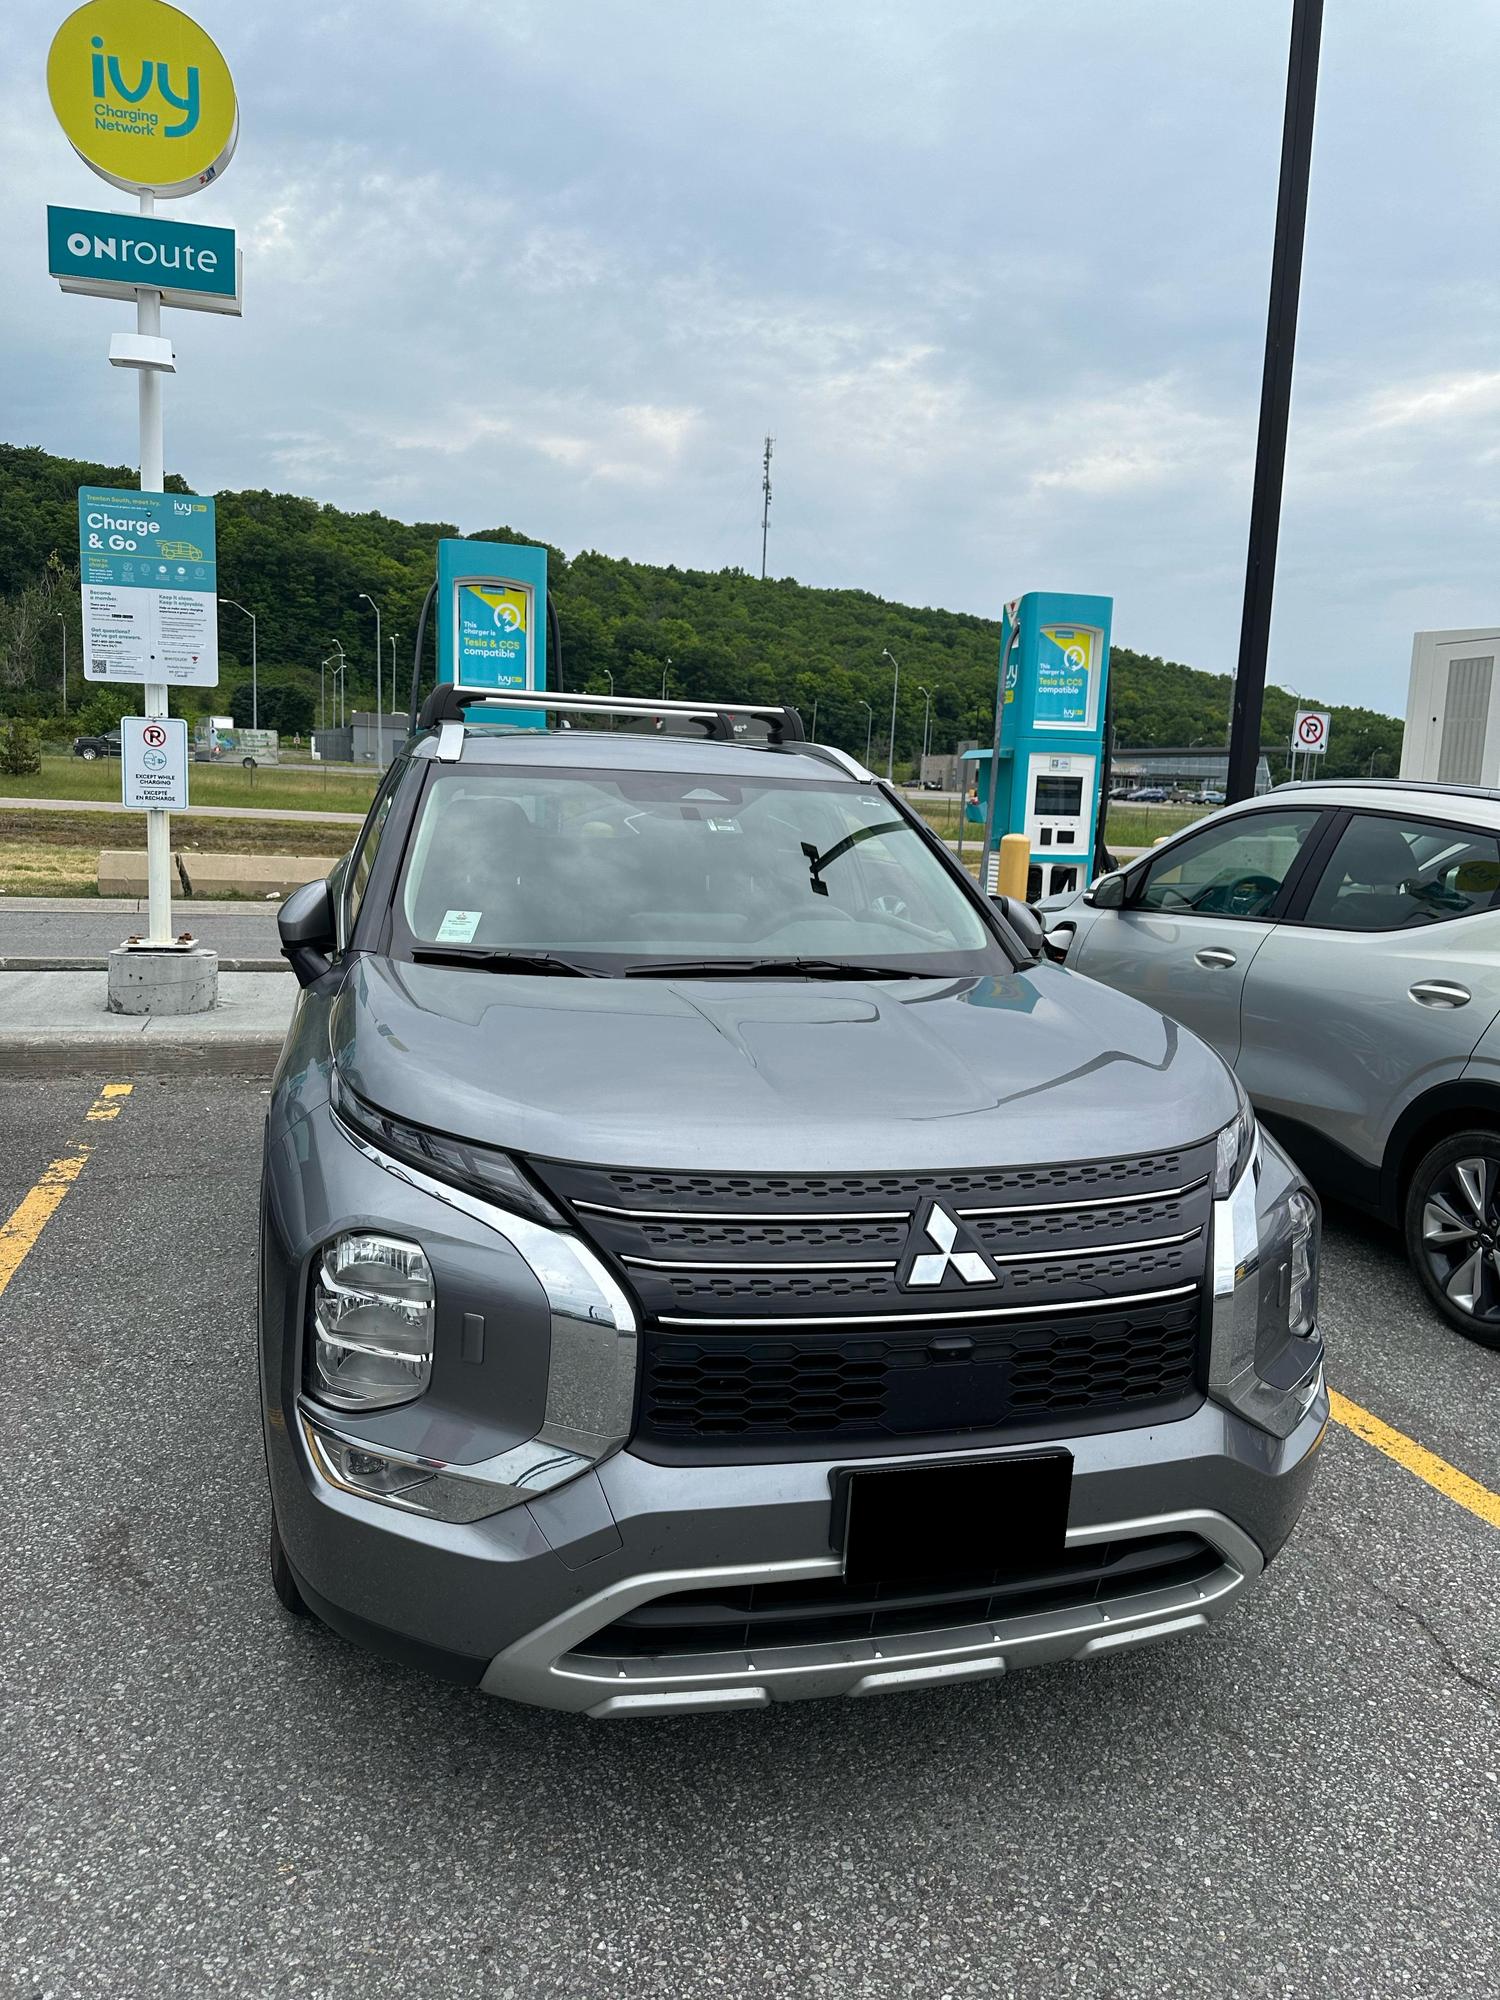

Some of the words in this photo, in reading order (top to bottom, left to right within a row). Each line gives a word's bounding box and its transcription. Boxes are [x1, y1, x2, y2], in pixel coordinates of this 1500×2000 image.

[91, 36, 200, 138] ivy
[94, 104, 159, 126] Charging
[95, 117, 155, 137] Network
[67, 232, 218, 273] ONroute
[174, 499, 192, 516] ivy
[87, 512, 161, 537] Charge
[88, 533, 104, 549] &
[108, 534, 137, 551] Go
[463, 628, 490, 636] charger
[464, 637, 488, 647] Tesla
[489, 639, 497, 648] &
[499, 640, 520, 650] CCS
[463, 648, 516, 658] compatible
[497, 674, 512, 685] ivy
[1039, 677, 1058, 685] Tesla
[1059, 678, 1065, 686] &
[1066, 678, 1083, 687] CCS
[1038, 686, 1080, 695] compatible
